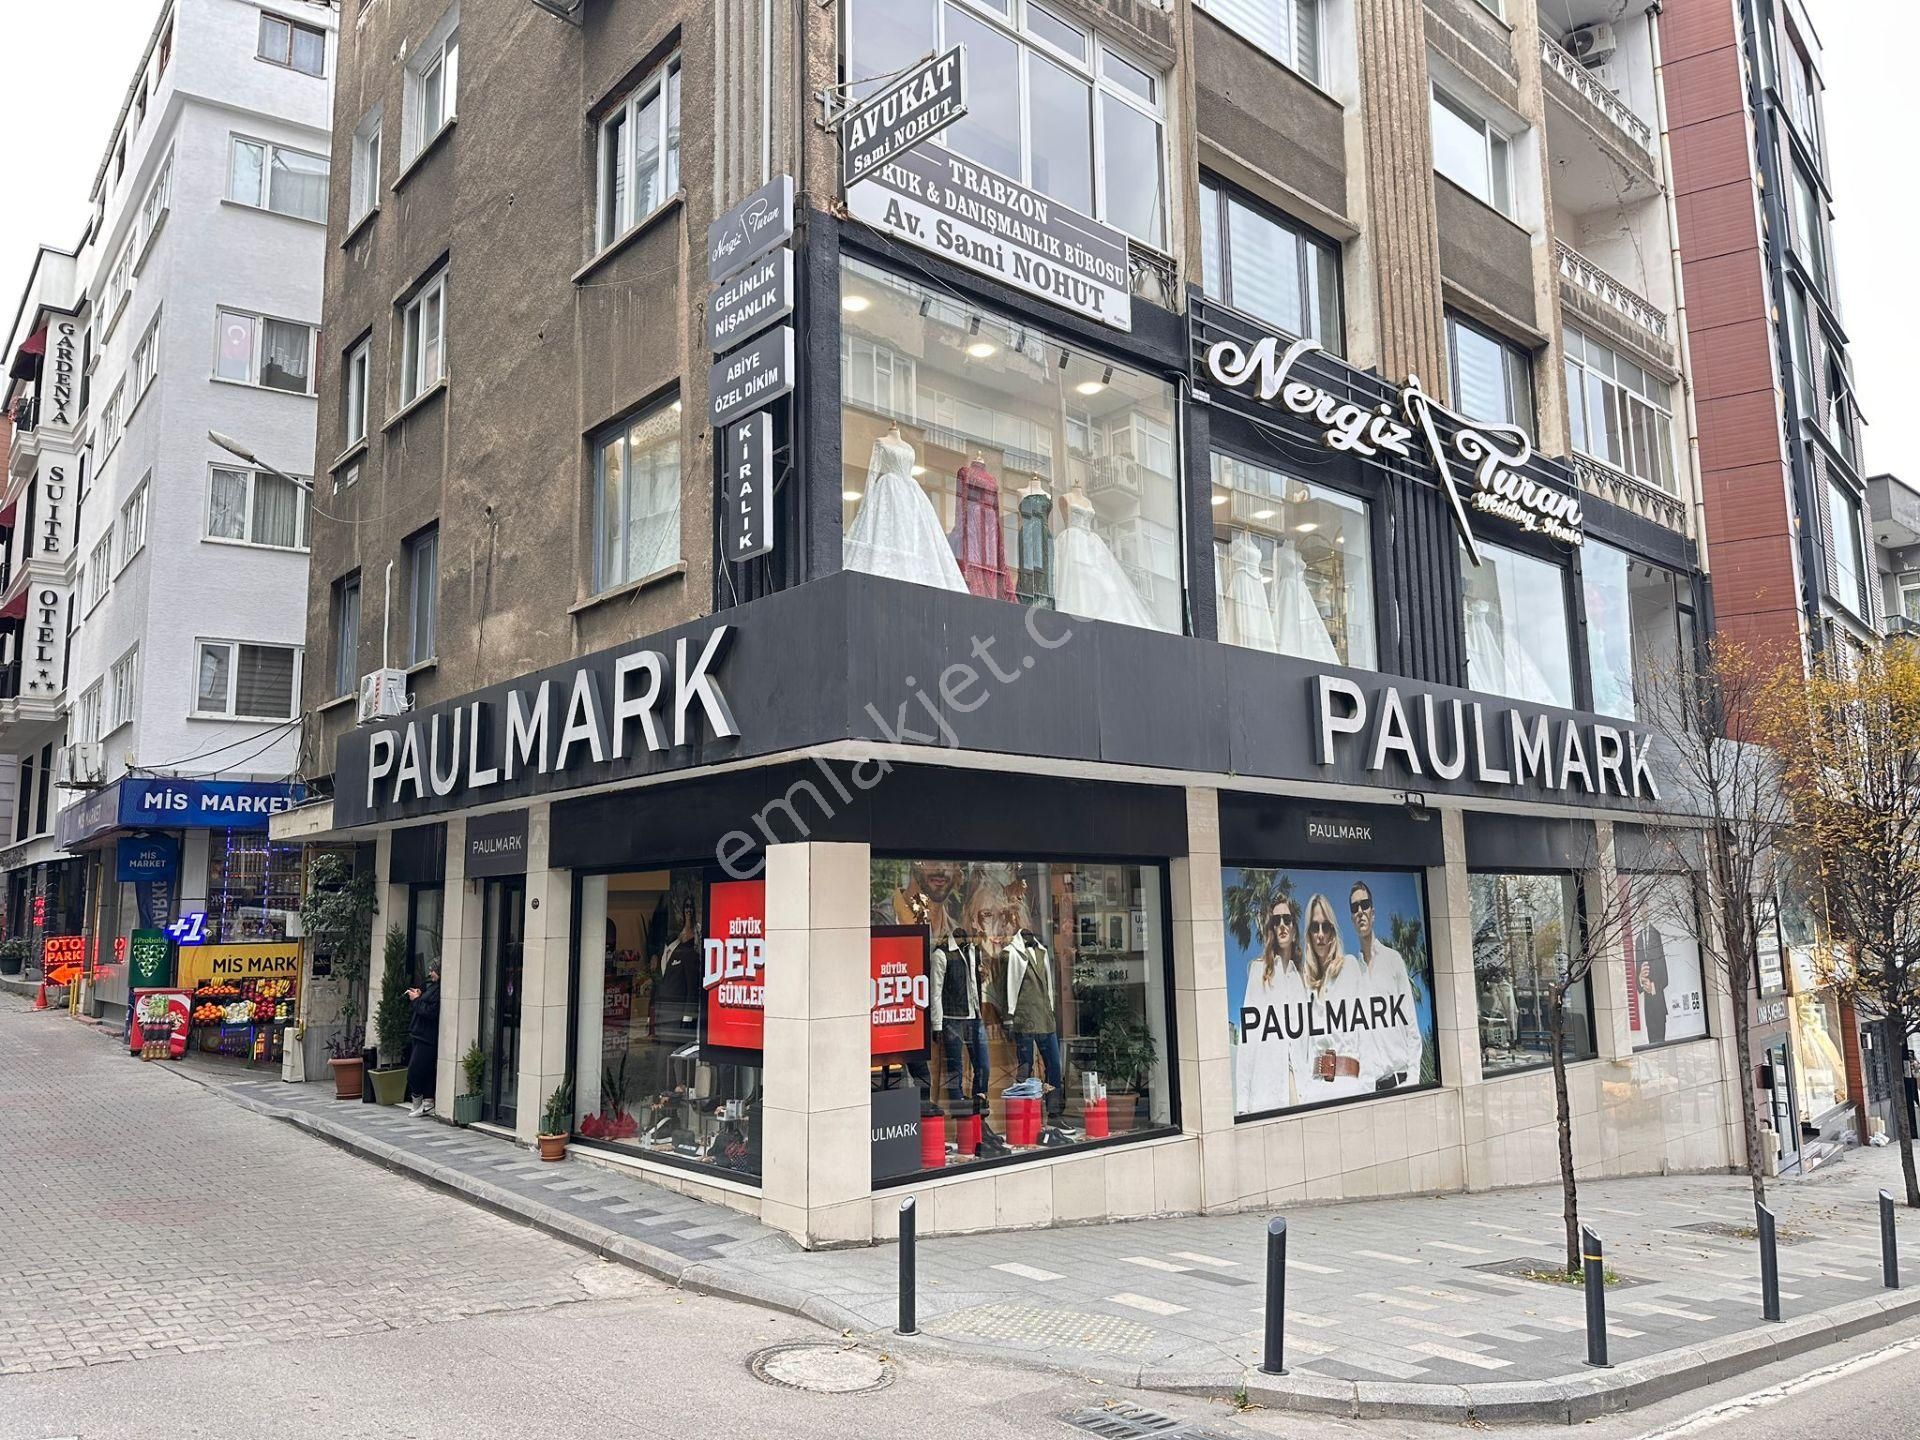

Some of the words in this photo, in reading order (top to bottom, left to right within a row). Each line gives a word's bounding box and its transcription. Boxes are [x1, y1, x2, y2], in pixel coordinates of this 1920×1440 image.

[849, 55, 954, 151] AVUKAT
[854, 137, 890, 174] Sami
[894, 97, 952, 148] NOHUT
[949, 159, 1048, 224] TRABZON
[712, 231, 742, 261] Nergiz
[749, 205, 779, 233] Turan
[884, 198, 925, 239] Av.
[936, 219, 1004, 272] Sami
[1013, 251, 1104, 313] NOHUT
[927, 181, 940, 203] &
[945, 188, 1061, 258] DANIŞMANLIK
[1064, 243, 1124, 286] BÜROSU
[715, 263, 775, 312] GELİNLİK
[715, 288, 776, 338] NİŞANLIK
[51, 322, 76, 425] GARDENYA
[715, 386, 742, 413] ÖZEL
[745, 368, 778, 395] DİKİM
[727, 352, 760, 383] ABİYE
[1207, 337, 1413, 456] Nergiz
[1454, 427, 1583, 527] Turan
[42, 466, 64, 552] SUITE
[739, 423, 752, 550] KİRALIK
[1477, 491, 1538, 531] Wedding
[36, 590, 58, 662] OTEL
[366, 624, 741, 808] PAULMARK
[1314, 674, 1662, 801] PAULMARK
[144, 788, 188, 811] MİS
[201, 794, 294, 814] MARKET
[472, 835, 522, 854] PAULMARK
[1309, 823, 1372, 840] PAULMARK
[129, 859, 167, 867] MARKET
[47, 938, 81, 950] OTO
[729, 917, 762, 935] BÜYÜK
[47, 951, 81, 962] PARK
[213, 954, 243, 973] MİS
[880, 962, 908, 975] BÜYÜK
[872, 1005, 916, 1025] GÜNLERİ
[1239, 993, 1409, 1044] PAULMARK
[871, 1122, 918, 1142] ULMARK
